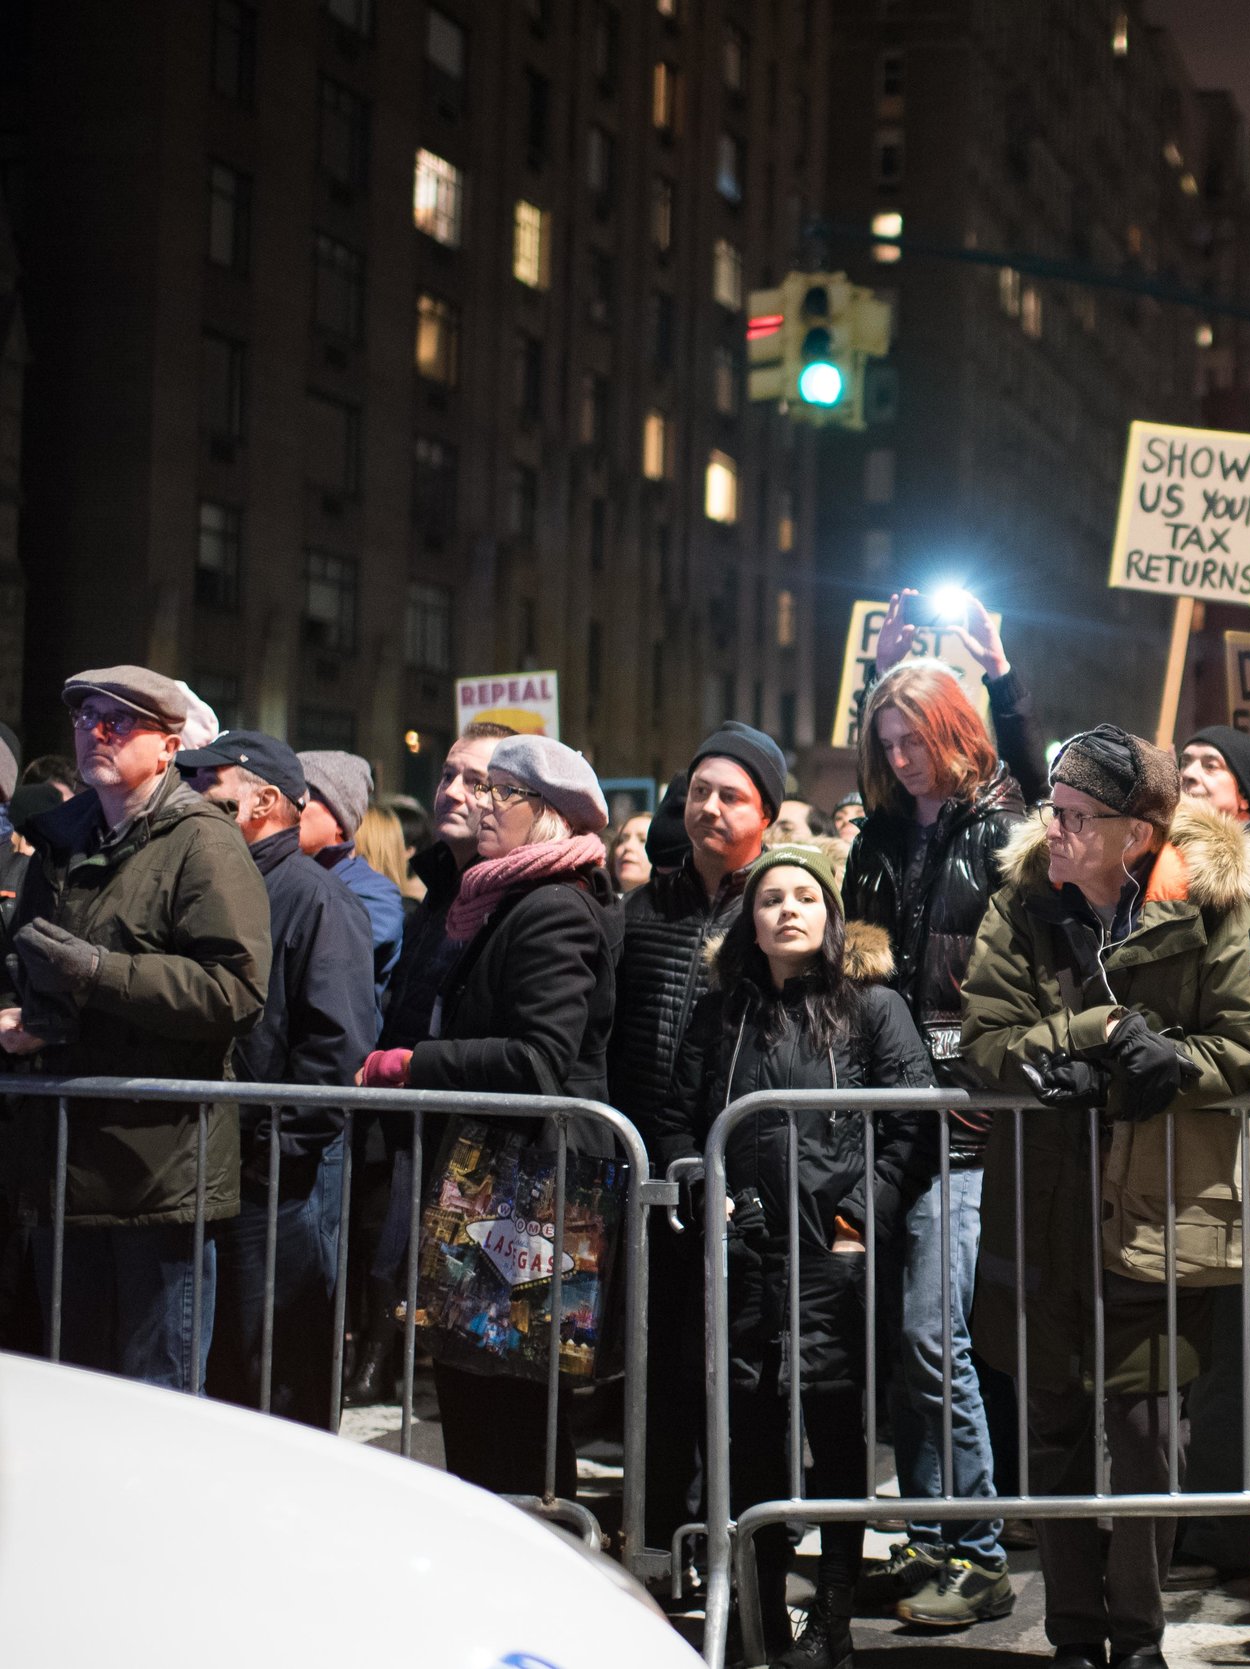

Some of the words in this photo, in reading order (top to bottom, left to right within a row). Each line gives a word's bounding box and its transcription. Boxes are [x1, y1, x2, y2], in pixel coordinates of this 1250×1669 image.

[1138, 481, 1185, 519] US
[1164, 522, 1232, 554] TAX
[460, 679, 552, 706] REPEAL
[484, 1230, 514, 1257] LAS
